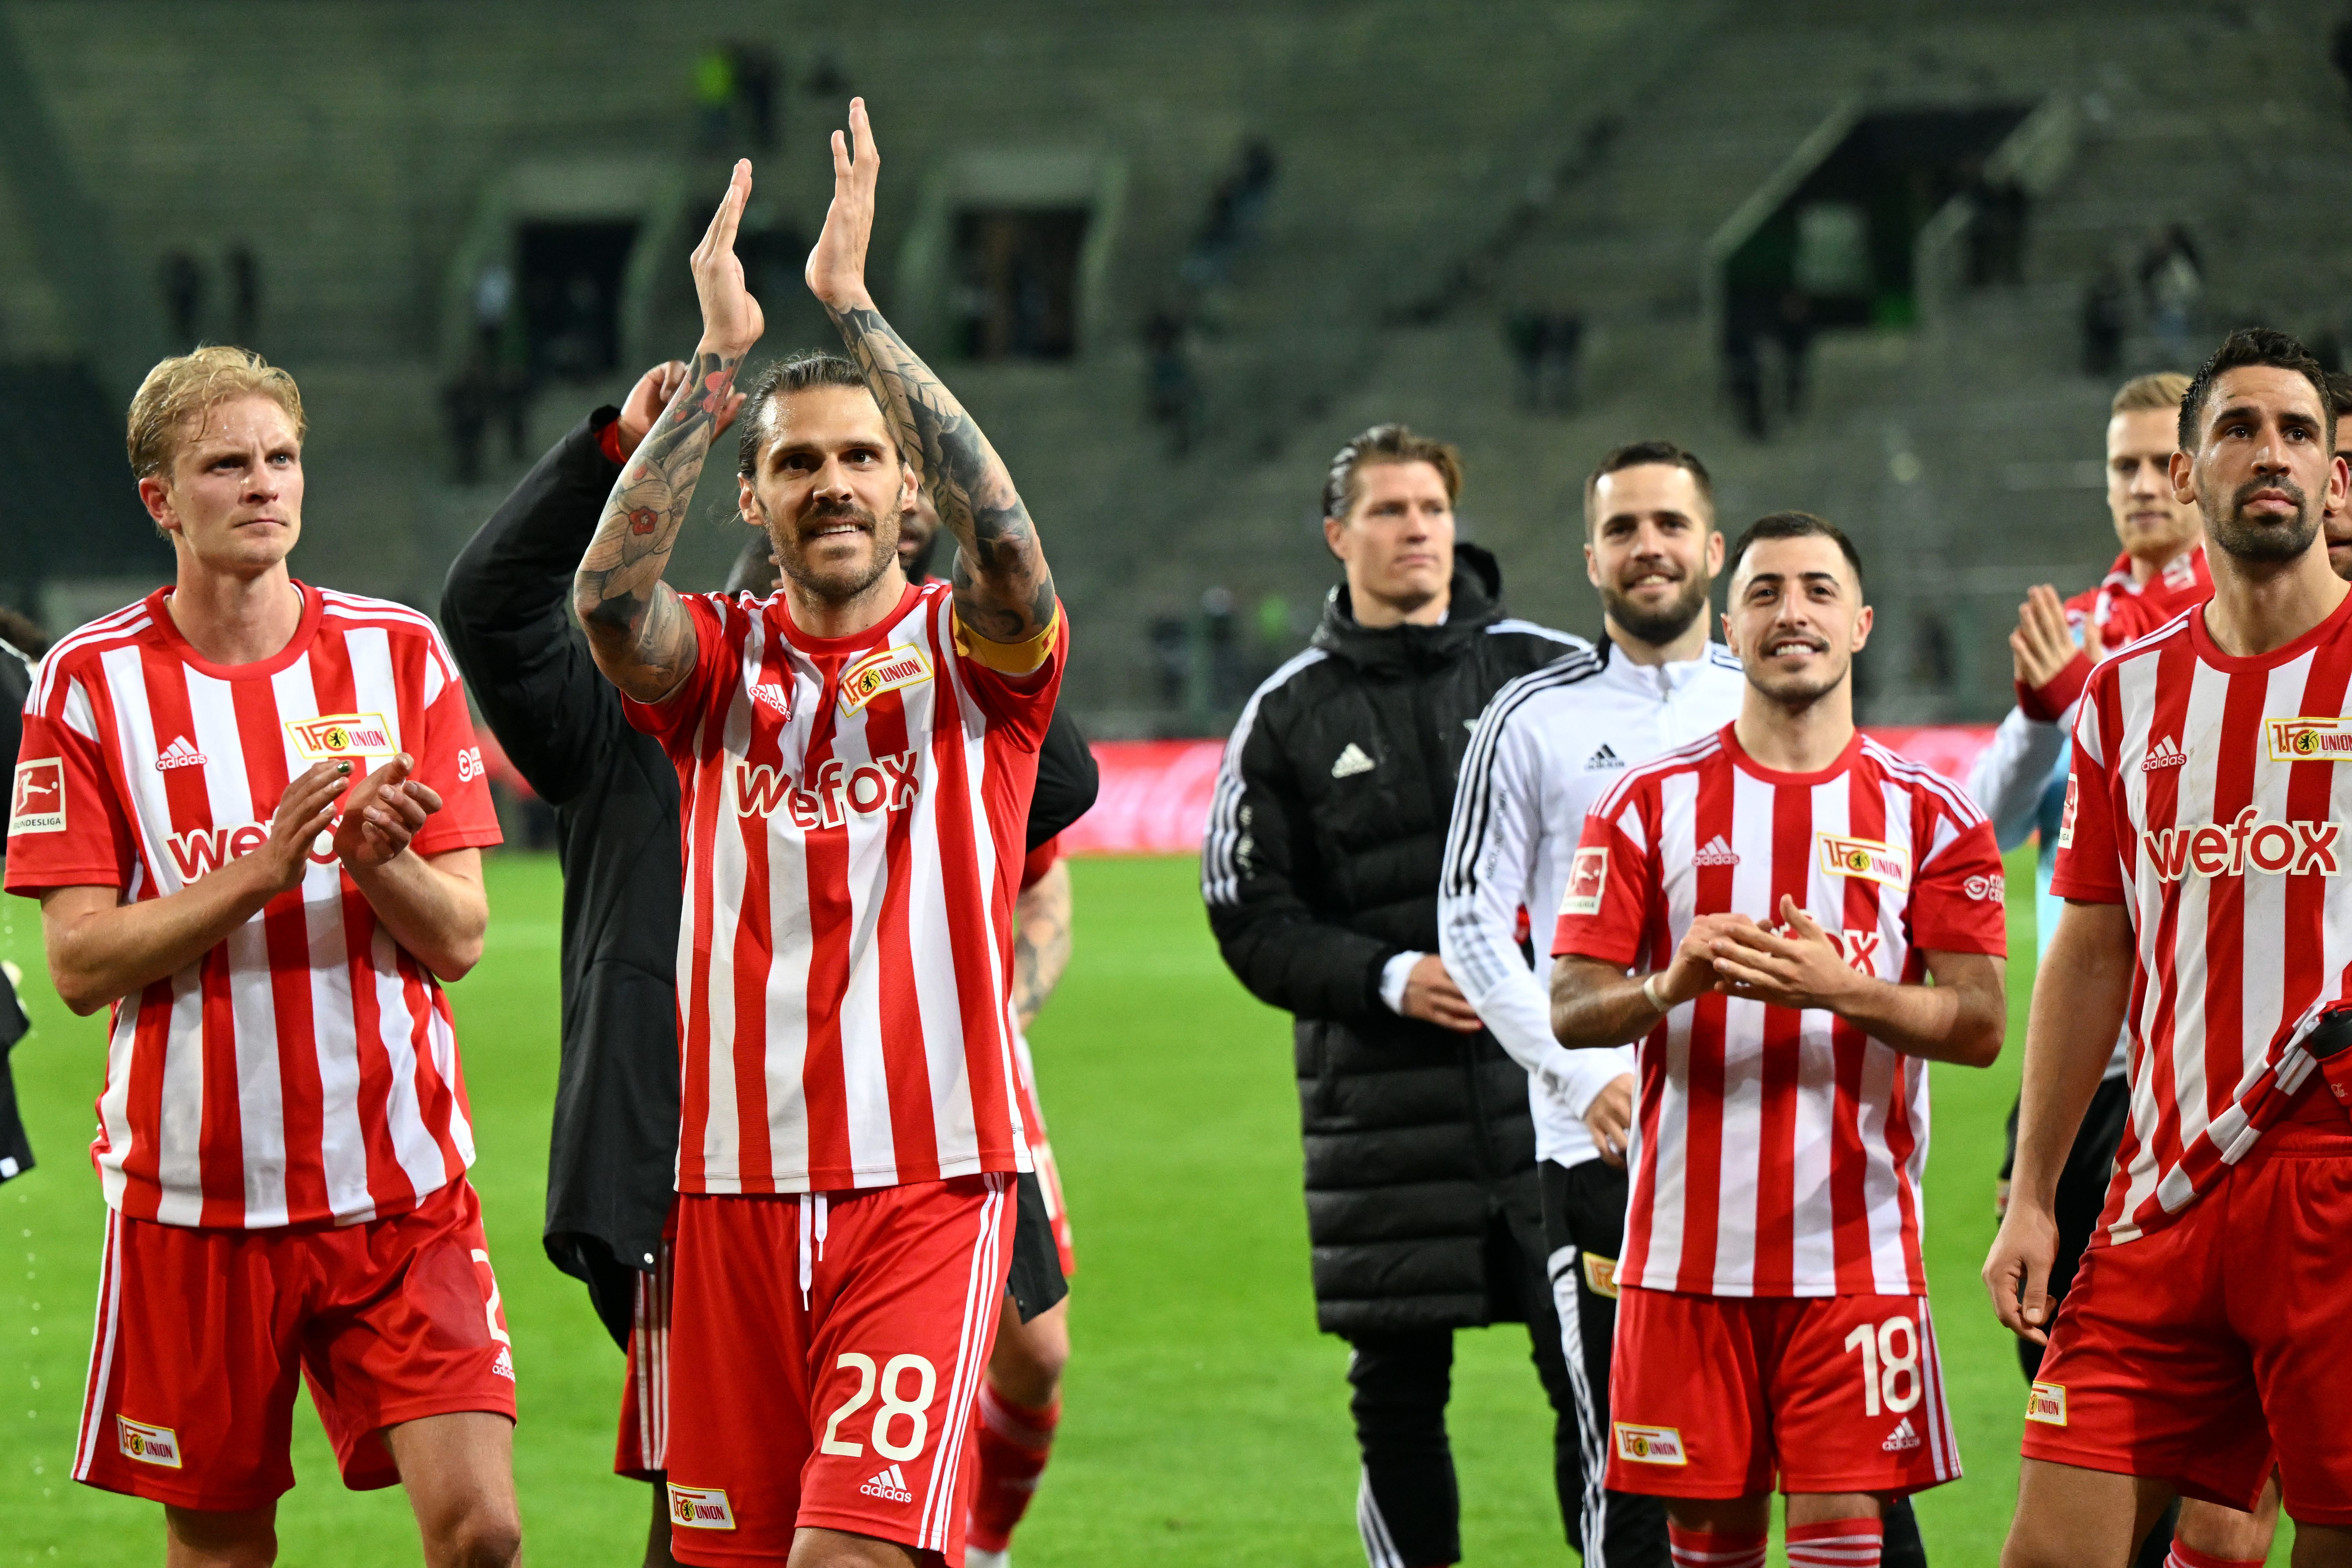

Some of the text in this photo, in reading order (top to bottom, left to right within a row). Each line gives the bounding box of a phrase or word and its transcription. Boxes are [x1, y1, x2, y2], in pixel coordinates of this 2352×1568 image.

[878, 659, 922, 682] UNION
[750, 687, 791, 721] adidas
[348, 730, 386, 746] UNION
[156, 754, 207, 770] adidas
[2141, 755, 2185, 771] adidas
[736, 749, 921, 829] wefox
[13, 817, 61, 829] BUNDESLIGA
[2142, 807, 2340, 880] wefox
[1691, 854, 1739, 866] adidas
[1871, 857, 1902, 880] UNION
[492, 1365, 515, 1383] adida
[1844, 1316, 1920, 1417] 18
[820, 1352, 936, 1462] 28
[2038, 1398, 2059, 1416] UNION
[145, 1440, 173, 1458] UNION
[1649, 1442, 1677, 1455] UNION
[1882, 1436, 1920, 1451] adidas
[860, 1484, 912, 1503] adidas
[695, 1504, 726, 1520] UNION
